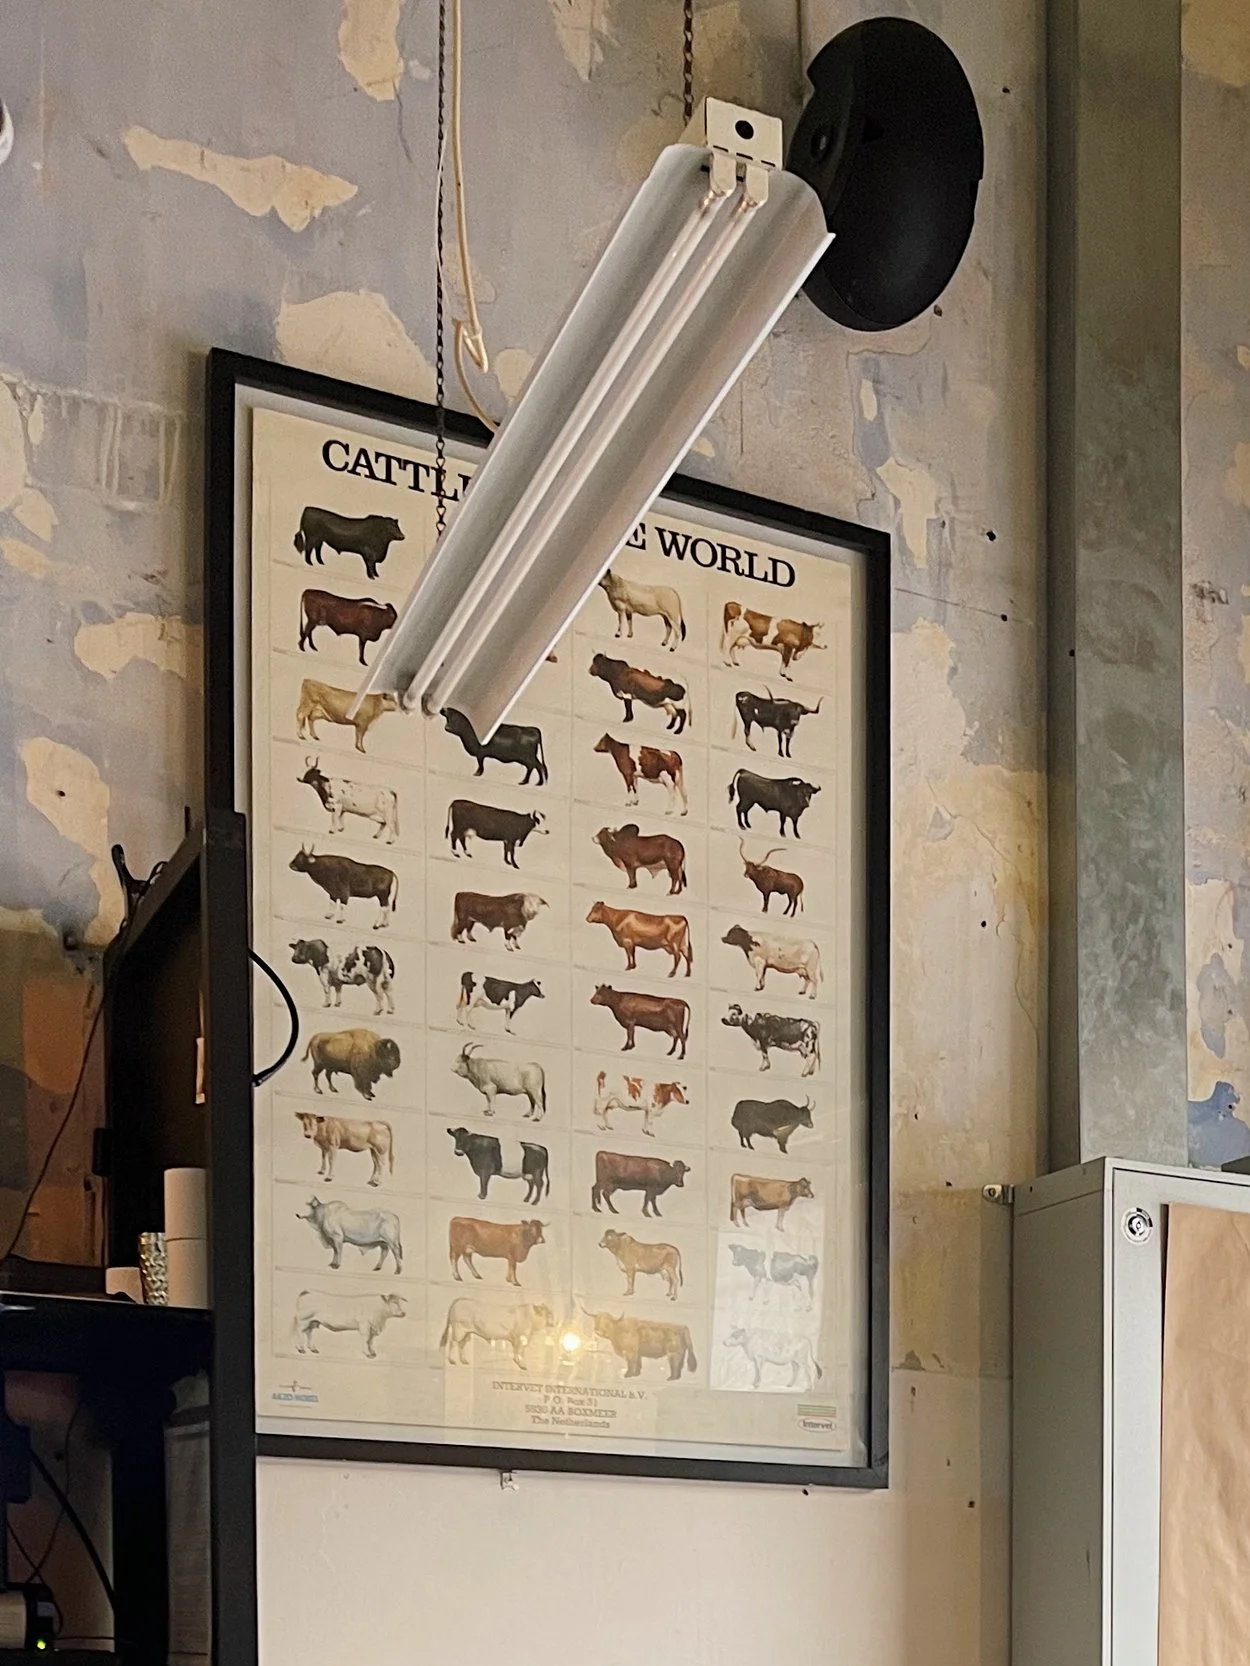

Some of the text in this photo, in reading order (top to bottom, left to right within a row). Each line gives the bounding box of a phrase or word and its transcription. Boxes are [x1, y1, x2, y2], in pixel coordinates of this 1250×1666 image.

[654, 526, 796, 588] WORLD
[492, 1381, 543, 1393] INTERVET
[545, 1385, 627, 1398] INTERNATIONAL
[567, 1397, 584, 1406] Box
[549, 1406, 565, 1415] AA
[567, 1407, 617, 1418] BOXMEER
[530, 1415, 611, 1429] The Netherlands
